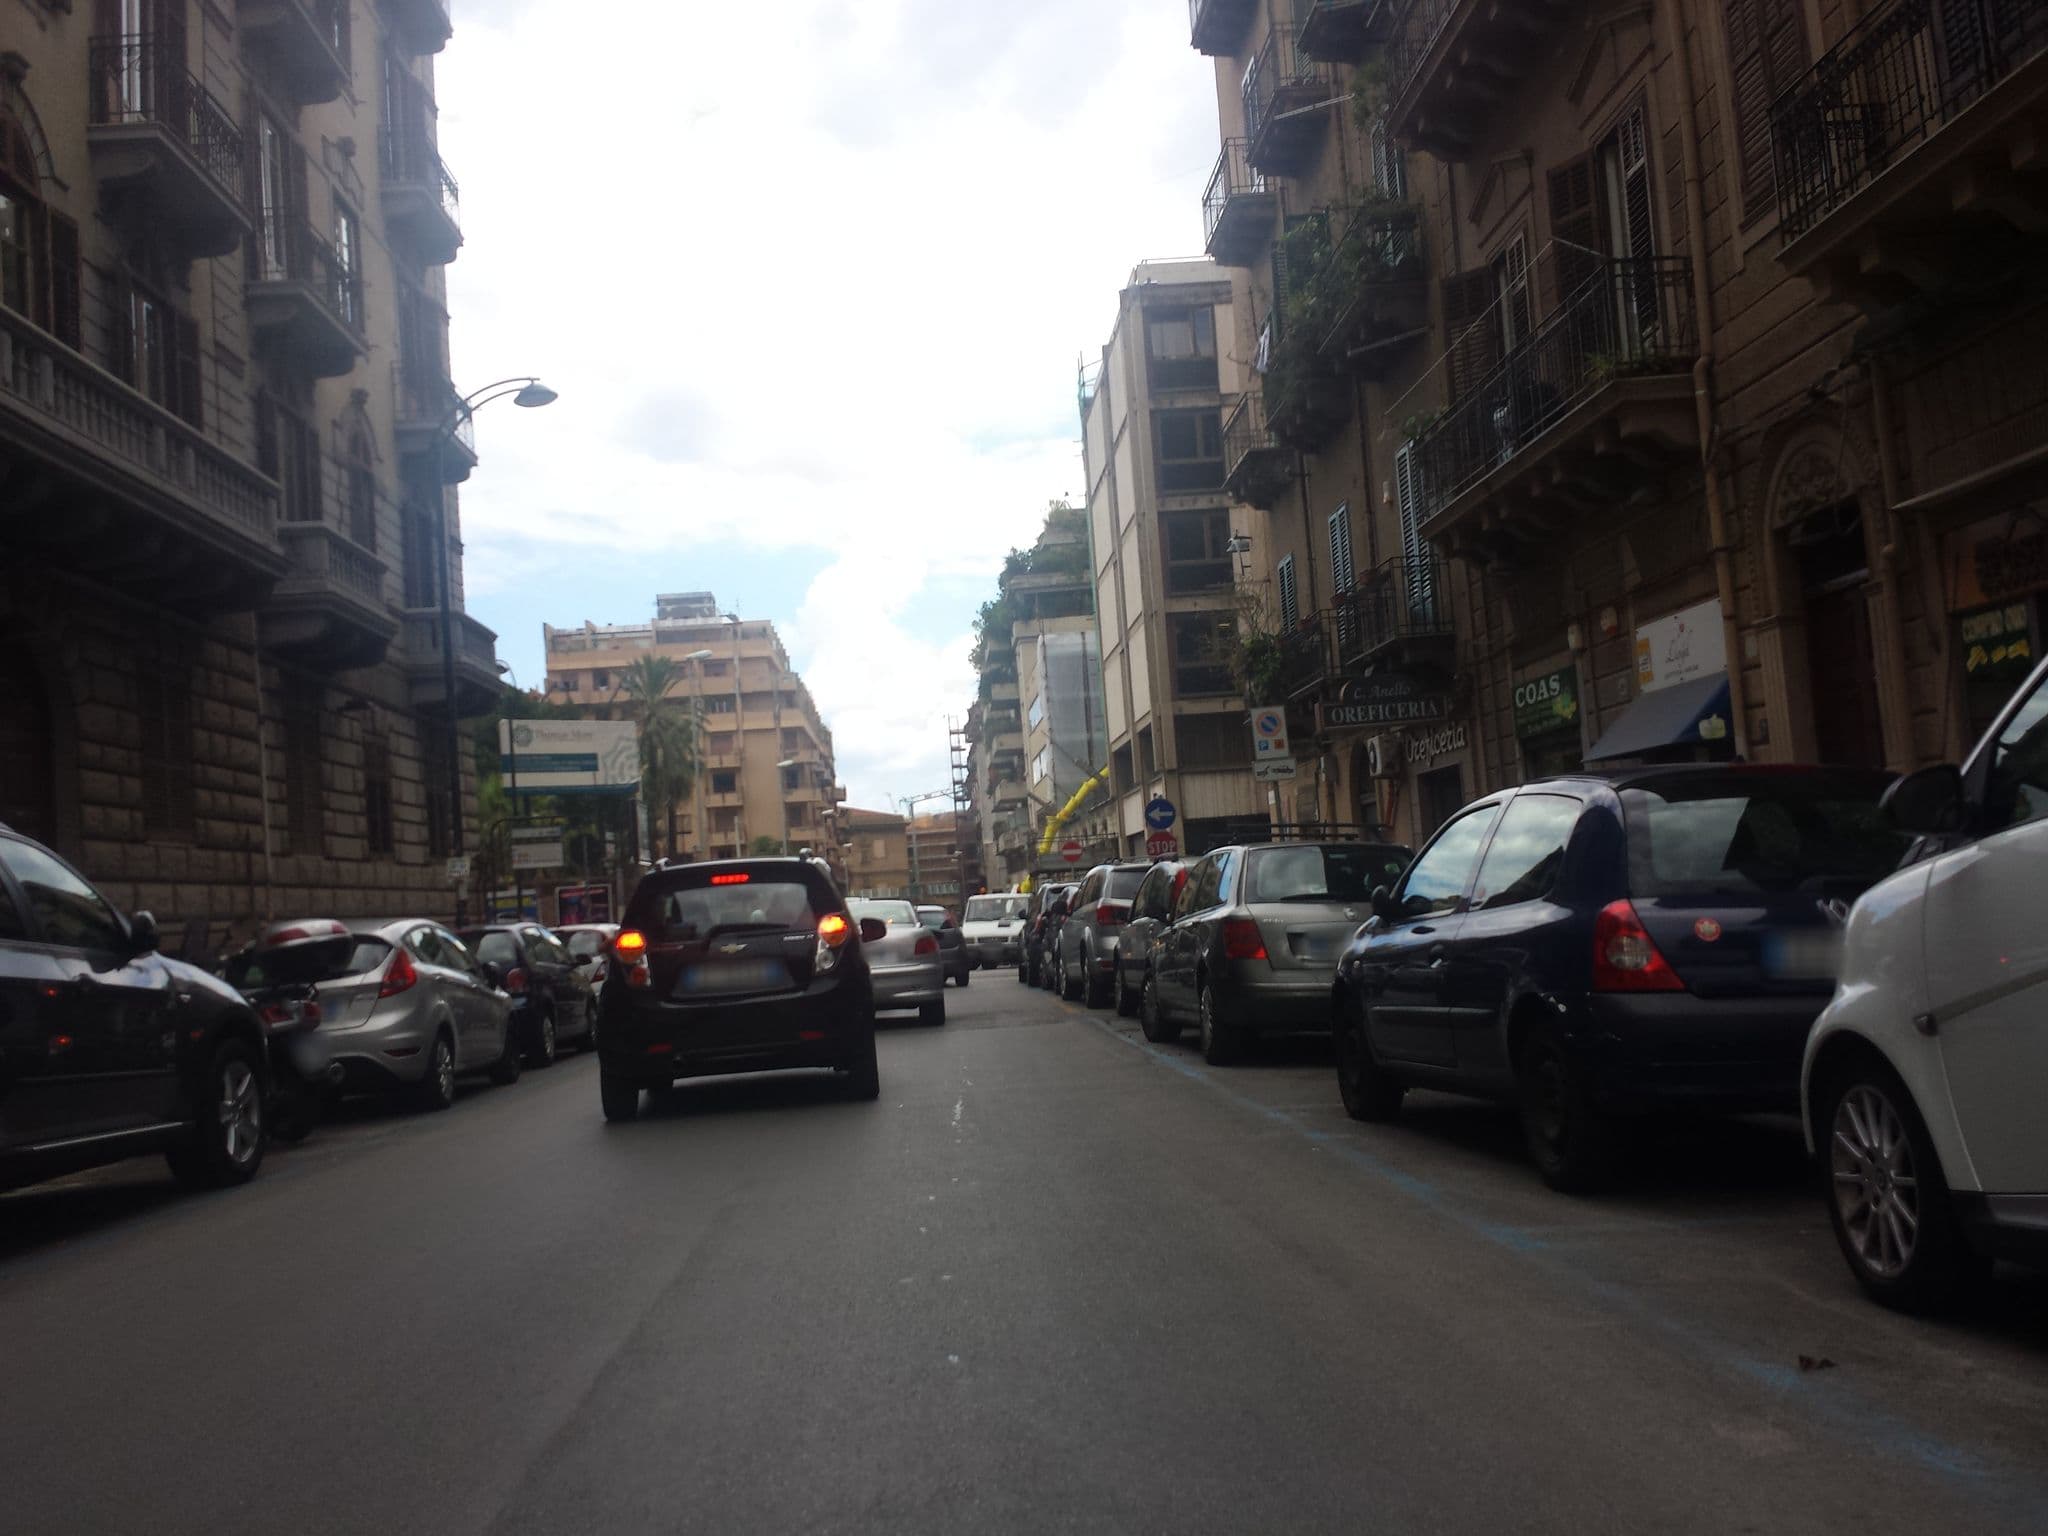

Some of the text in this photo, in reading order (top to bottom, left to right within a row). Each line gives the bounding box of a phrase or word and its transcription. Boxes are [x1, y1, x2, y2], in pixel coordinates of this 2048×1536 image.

[1515, 674, 1561, 708] COAS
[1331, 700, 1439, 723] OREFICERIA
[1405, 722, 1466, 766] Oreficeria
[1147, 840, 1176, 855] STOP
